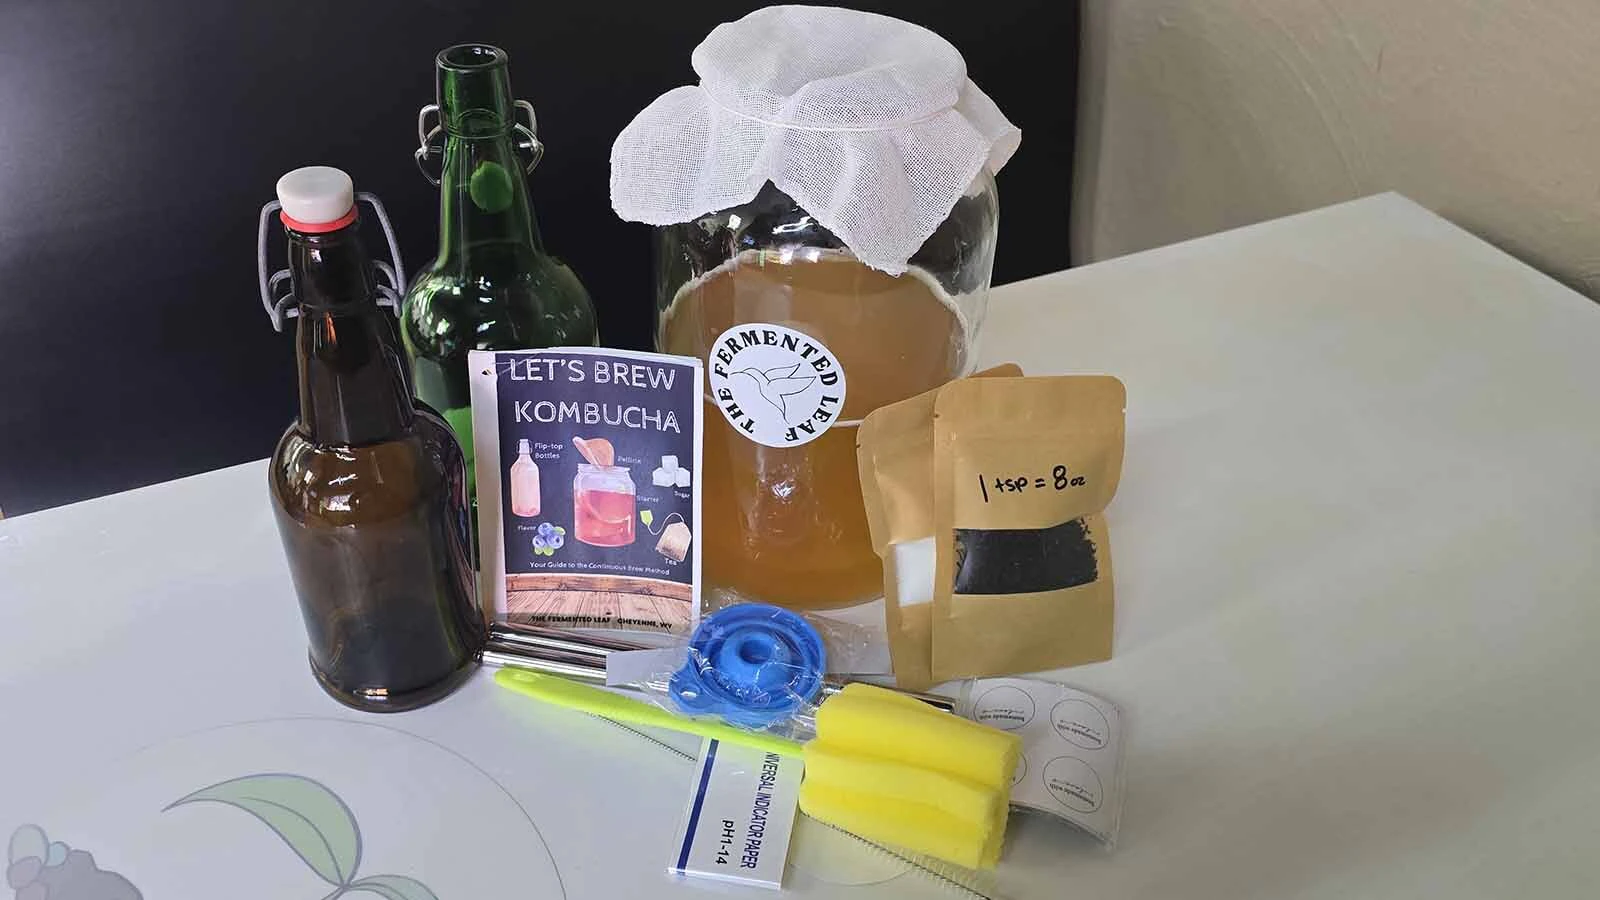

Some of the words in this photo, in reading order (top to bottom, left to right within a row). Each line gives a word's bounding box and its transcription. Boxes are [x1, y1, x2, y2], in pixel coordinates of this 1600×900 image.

[714, 329, 839, 386] FERMENTED
[510, 358, 585, 382] LET'S
[594, 361, 676, 390] BREW
[514, 400, 681, 434] KOMBUCHA
[718, 387, 755, 434] THE
[785, 395, 839, 441] LEAF
[534, 442, 564, 452] Flip-top
[534, 452, 560, 460] Bottles
[673, 490, 691, 499] Sugar
[995, 477, 1028, 493] tsp
[529, 561, 546, 569] Your
[577, 561, 588, 569] the
[588, 562, 626, 571] Continuous
[645, 566, 670, 575] Method
[664, 558, 678, 566] Tea
[758, 751, 780, 791] NIVERSAL
[748, 793, 772, 839] INDICATOR
[715, 819, 735, 865] pH1-14
[740, 837, 761, 869] PAPER
